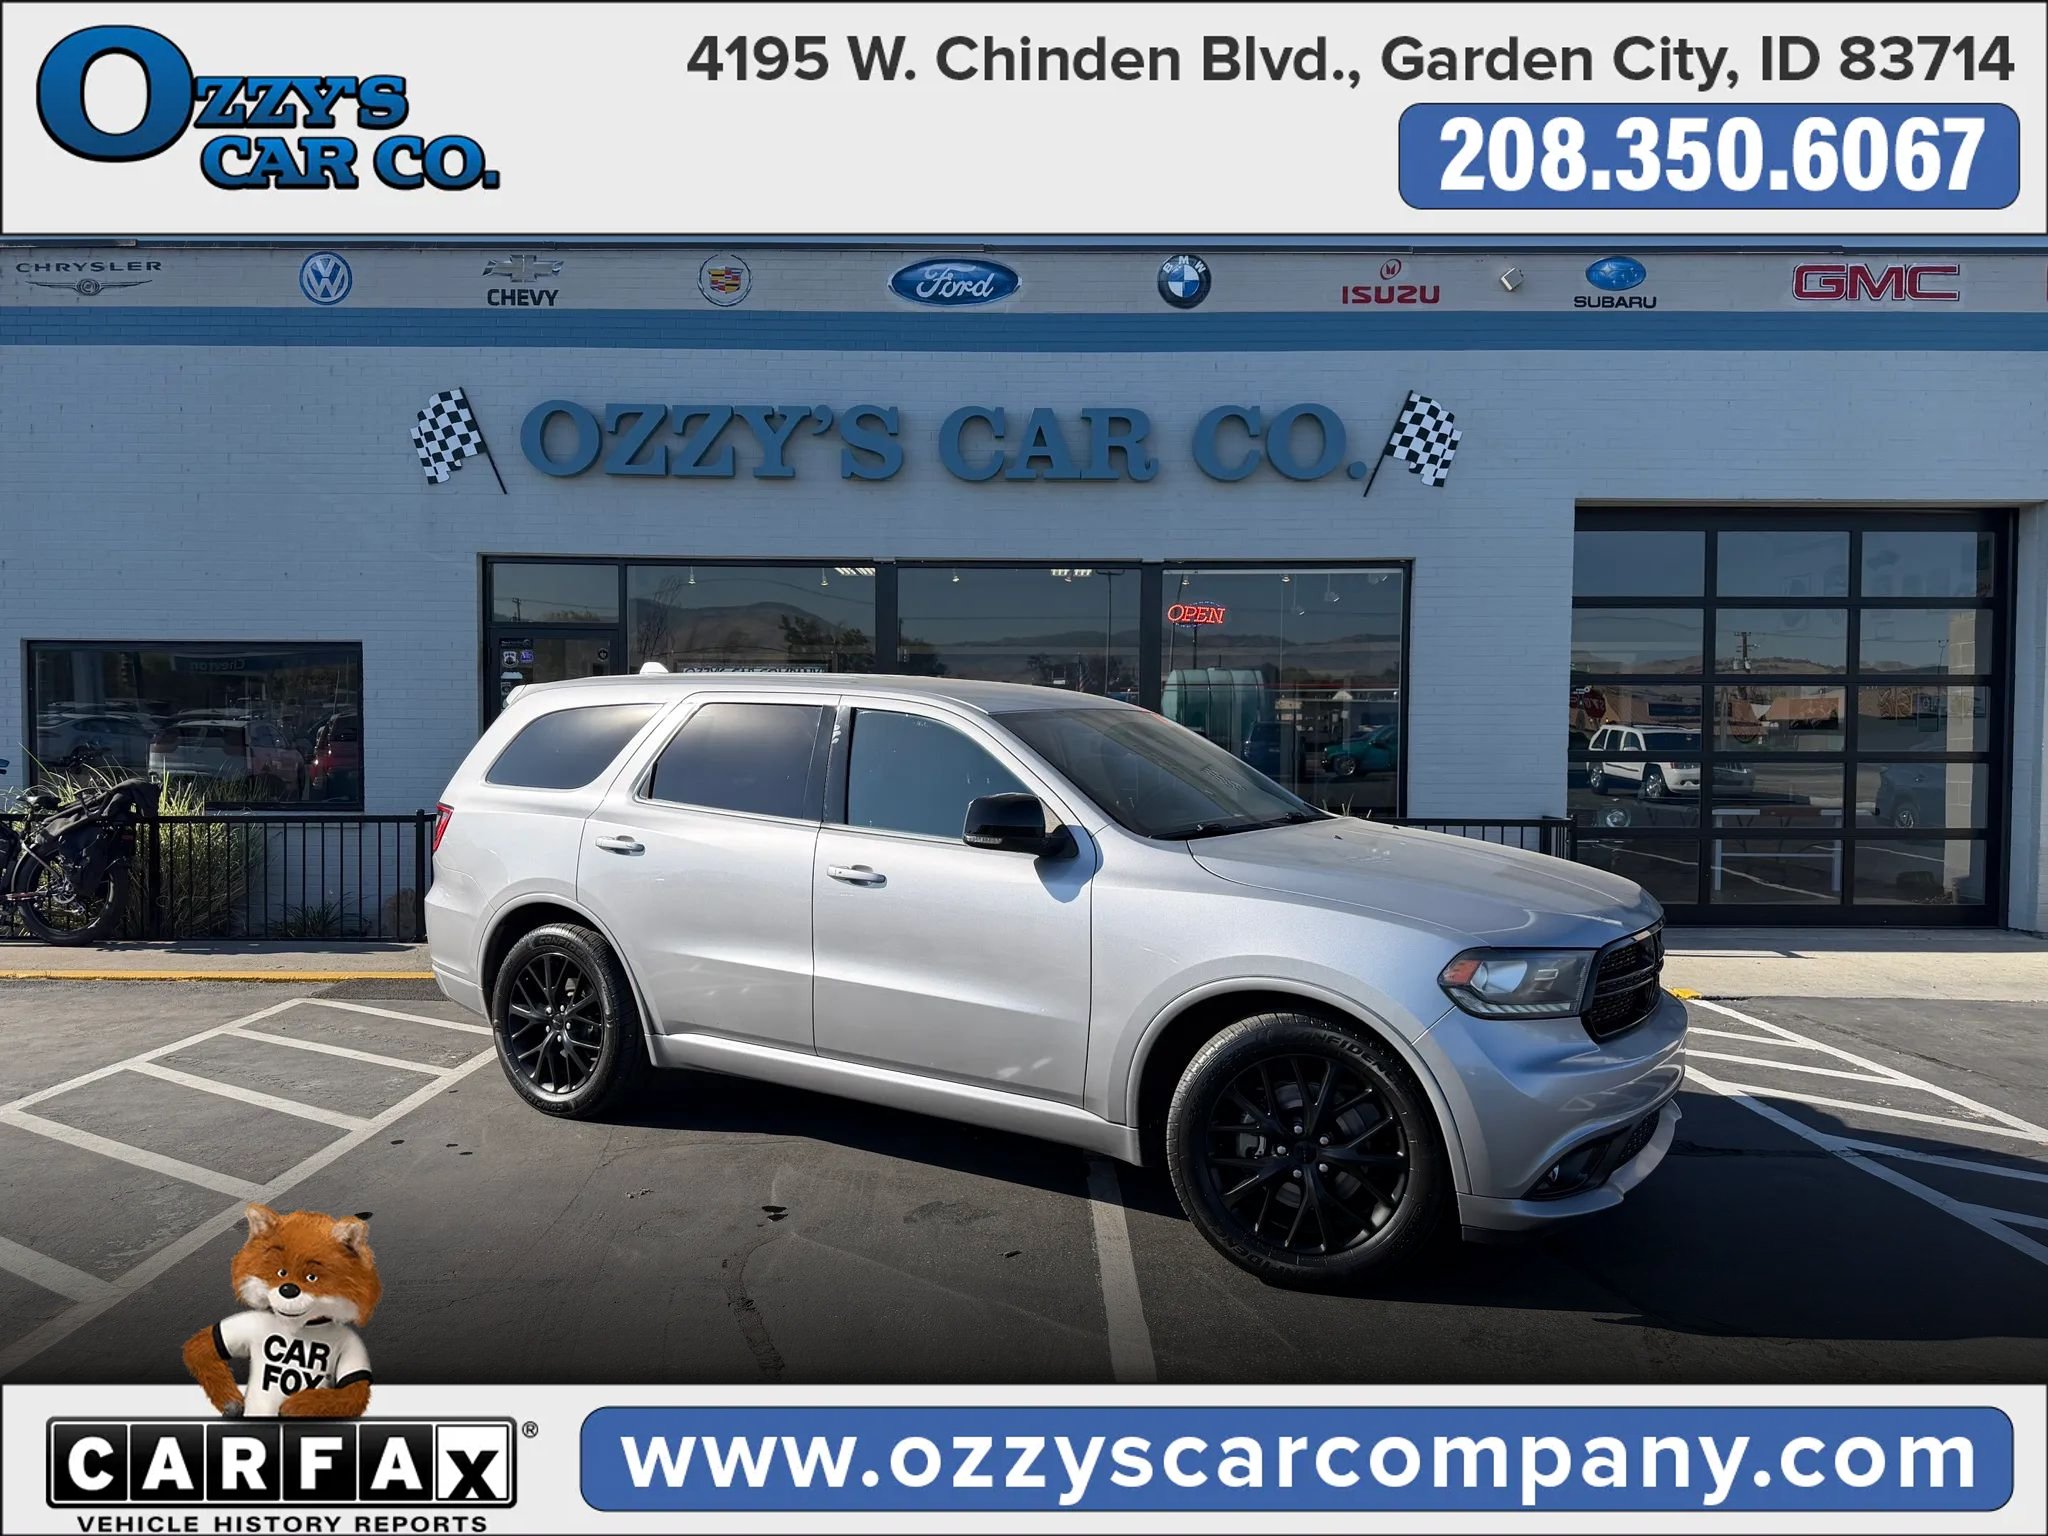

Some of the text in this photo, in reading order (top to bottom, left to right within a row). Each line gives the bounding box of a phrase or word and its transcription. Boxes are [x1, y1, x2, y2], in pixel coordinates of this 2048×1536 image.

[16, 261, 162, 273] CHRYSLER
[915, 265, 995, 299] Ford
[1792, 262, 1961, 302] GMC
[487, 289, 559, 306] CHEVY
[1342, 285, 1440, 304] ISUZU
[1574, 295, 1657, 309] SUBARU
[519, 399, 1368, 484] OZZY'S CAR CO.
[1167, 603, 1227, 625] OPEN
